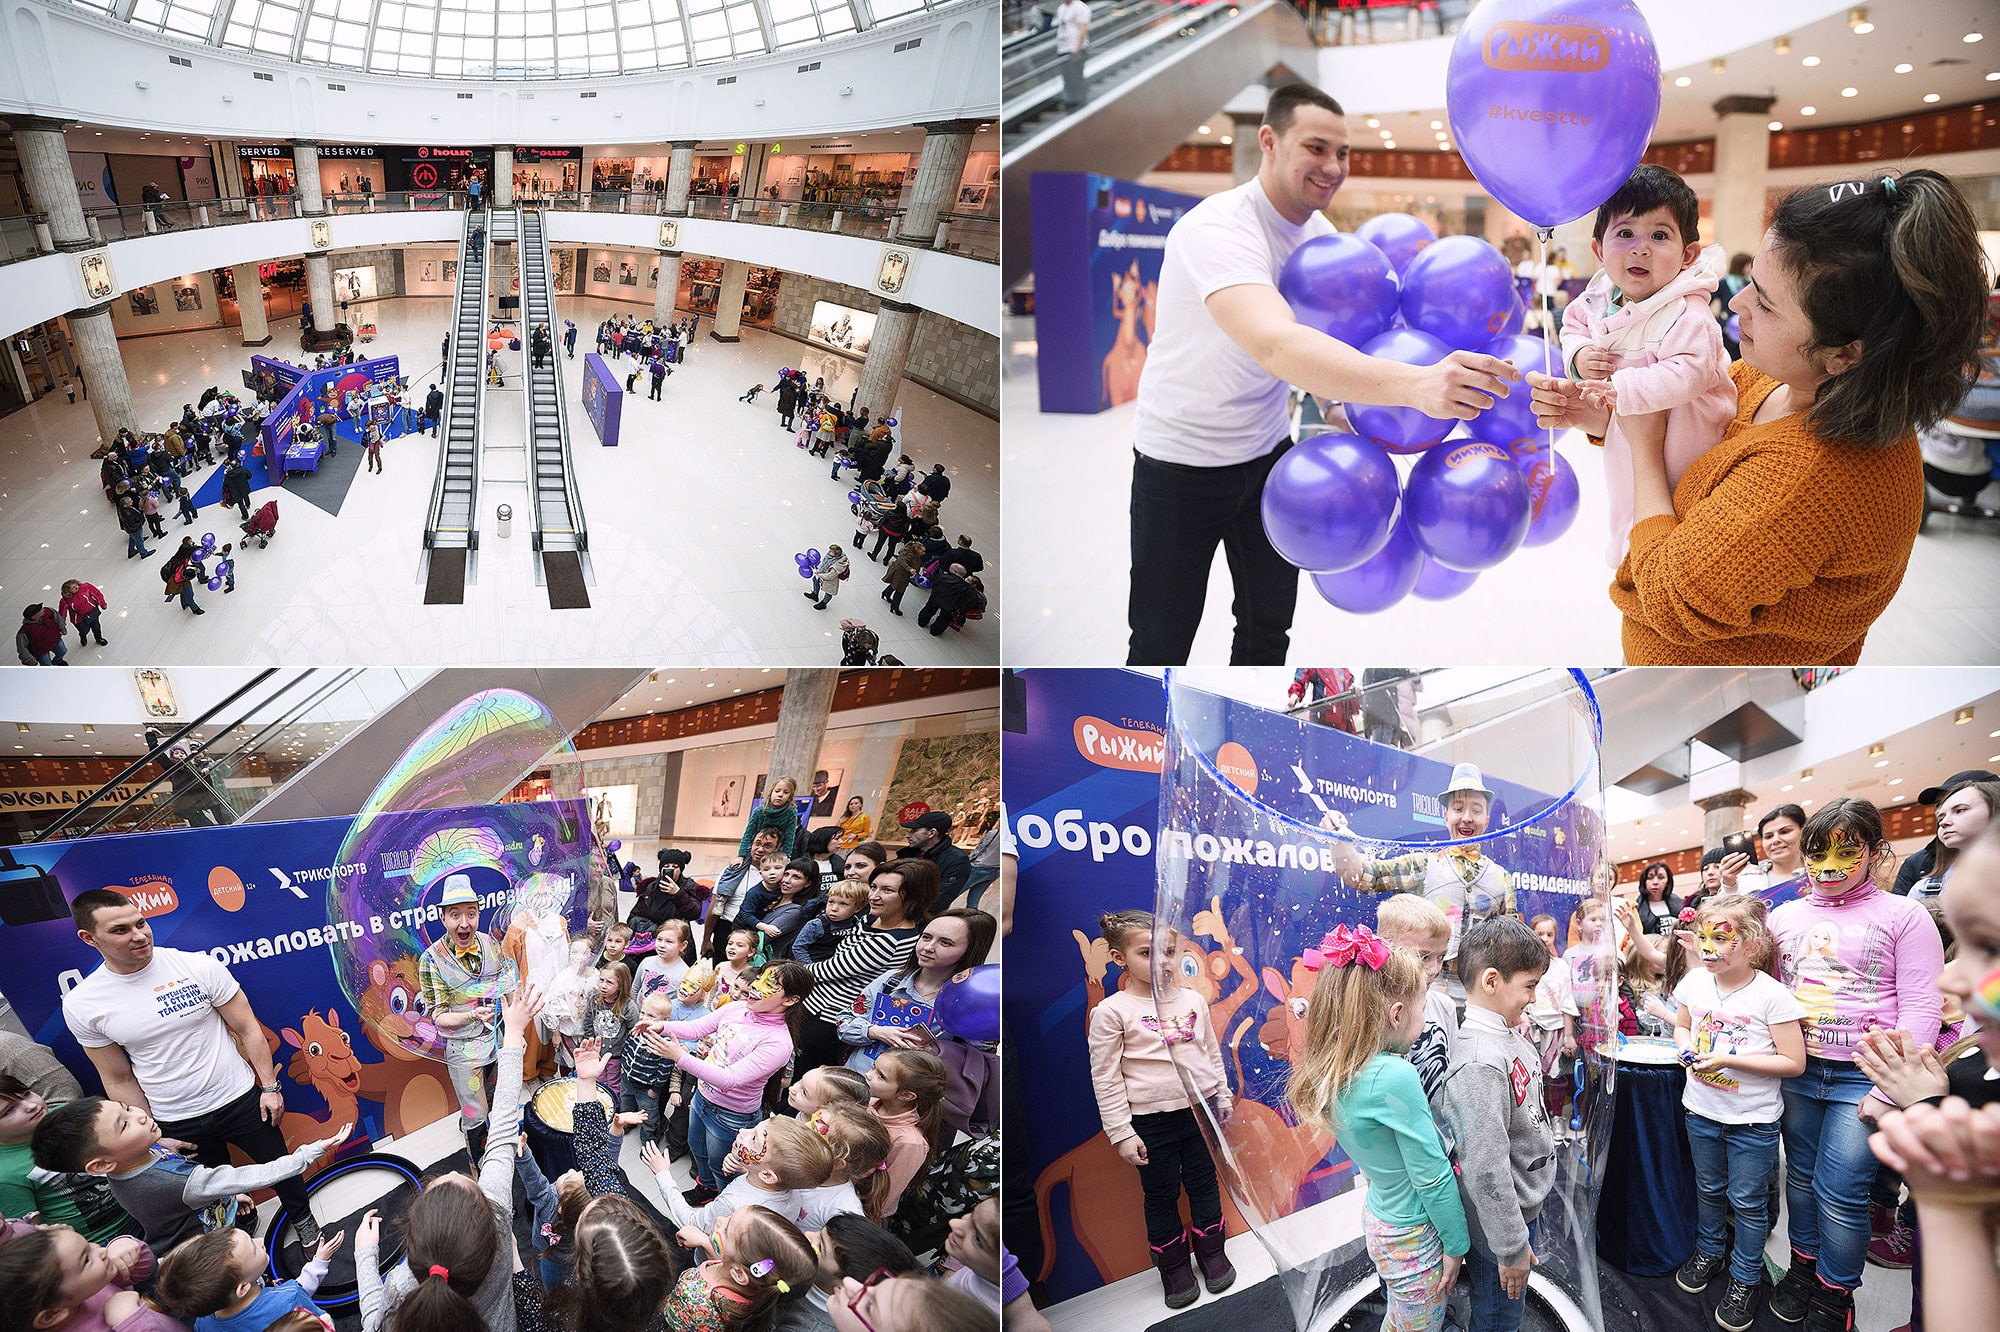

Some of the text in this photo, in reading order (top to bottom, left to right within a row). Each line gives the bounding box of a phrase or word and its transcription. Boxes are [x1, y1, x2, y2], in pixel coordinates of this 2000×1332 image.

[1488, 104, 1592, 126] #kvesttv
[238, 147, 281, 156] ESERVED
[317, 147, 374, 156] RESERVED
[1121, 717, 1168, 736] ТЕЛЕКАНА
[1220, 764, 1256, 778] ДЕТСКИЙ
[1260, 772, 1273, 782] 12+
[1316, 778, 1398, 808] ТРИКОЛОРТВ
[904, 807, 927, 815] SALE
[129, 874, 173, 885] ТЕЛЕКАНАЛ
[292, 862, 368, 884] ТРИКОЛОРТВ
[213, 883, 243, 897] ДЕТСКИЙ
[1511, 872, 1592, 895] левидения!
[197, 917, 365, 967] ожаловать
[370, 916, 384, 934] в
[170, 988, 201, 1005] СТРАНУ
[158, 993, 209, 1018] ТЕЛЕВИДЕНИ
[1817, 1013, 1855, 1026] Barbie
[1818, 1030, 1853, 1048] DOLL
